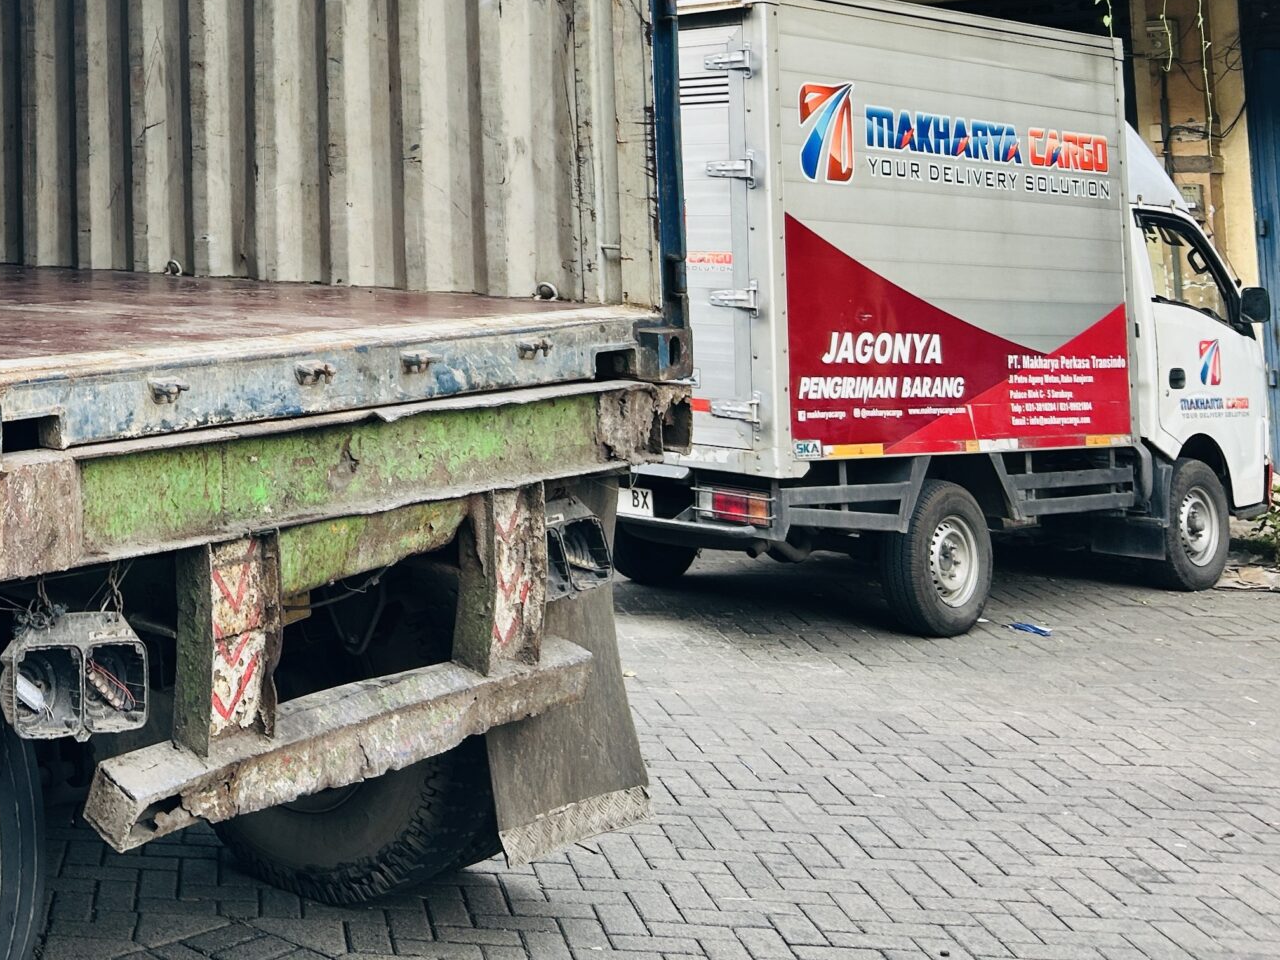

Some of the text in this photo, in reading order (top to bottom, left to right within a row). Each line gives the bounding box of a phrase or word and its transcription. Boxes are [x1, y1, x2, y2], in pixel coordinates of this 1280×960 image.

[865, 105, 1110, 175] MAKHARYA CARGO
[868, 157, 1111, 200] YOUR DELIVERY SOLUTION
[821, 331, 943, 365] JAGONYA
[1007, 354, 1126, 372] PT. Makharya Perkasa Transindo
[798, 376, 965, 404] PENGIRIMAN BARANG
[796, 443, 820, 454] SKA
[631, 489, 650, 510] BX
